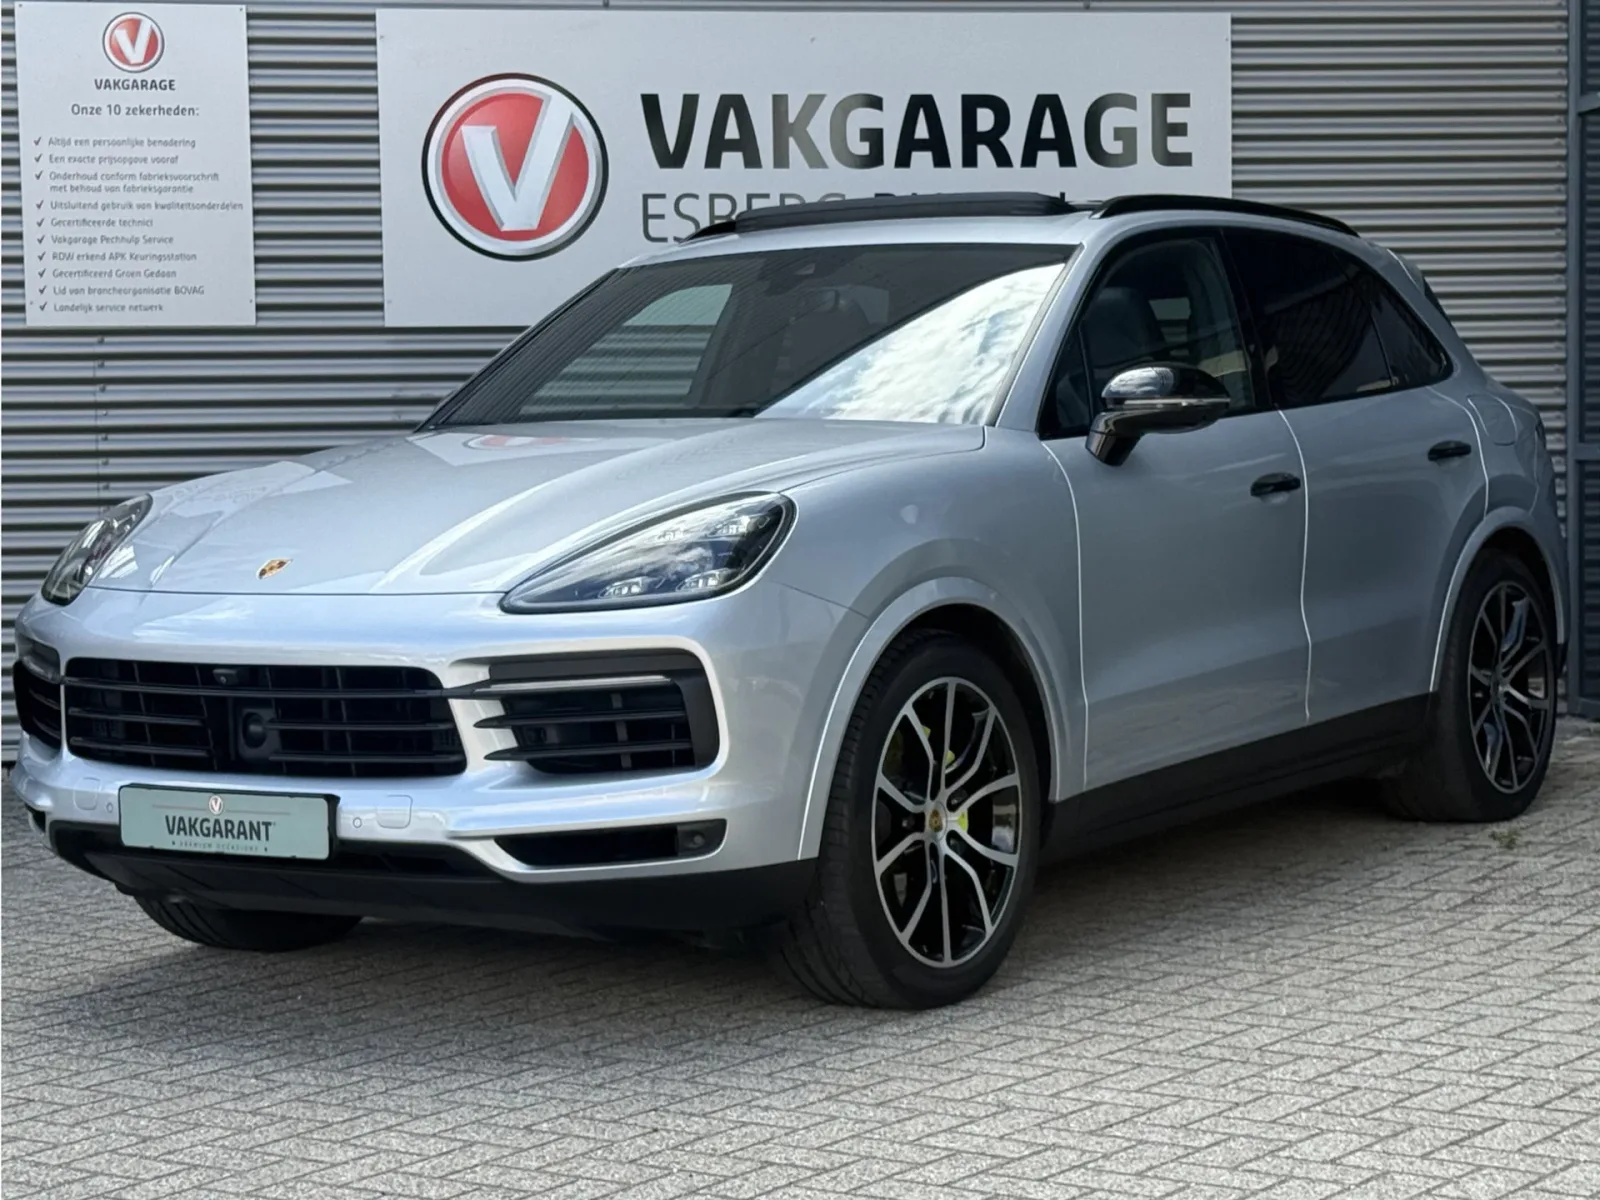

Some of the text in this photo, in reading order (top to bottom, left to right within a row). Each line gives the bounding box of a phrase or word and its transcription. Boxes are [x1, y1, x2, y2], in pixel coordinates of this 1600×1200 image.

[94, 79, 176, 91] VAKGARAGE
[71, 103, 200, 117] Onze 10 zekerheden:
[640, 93, 1193, 169] VAKGARAGE
[48, 137, 196, 149] Altijd een persoonlijke benadering
[49, 155, 179, 166] Een exacte prijsopgave vooraf
[49, 171, 220, 182] Onderhoud conform fabrieksvoorschrift
[49, 184, 194, 195] met behoud van fabrieksgarantie
[50, 200, 243, 212] Uitsluitend gebruik van kwaliteitsonderdelen
[51, 217, 153, 227] Gecertificeerde technici
[51, 235, 174, 246] Vakgarage Pechhulp Service
[52, 252, 197, 263] RDW erkend APK Keuringsstation
[52, 269, 177, 279] Gecertificeerd Groen Gedaan
[53, 286, 205, 297] Lid van brancheorganisatie BOVAG
[54, 303, 163, 314] Landelijk service netwerk
[165, 815, 272, 842] VAKGARANT
